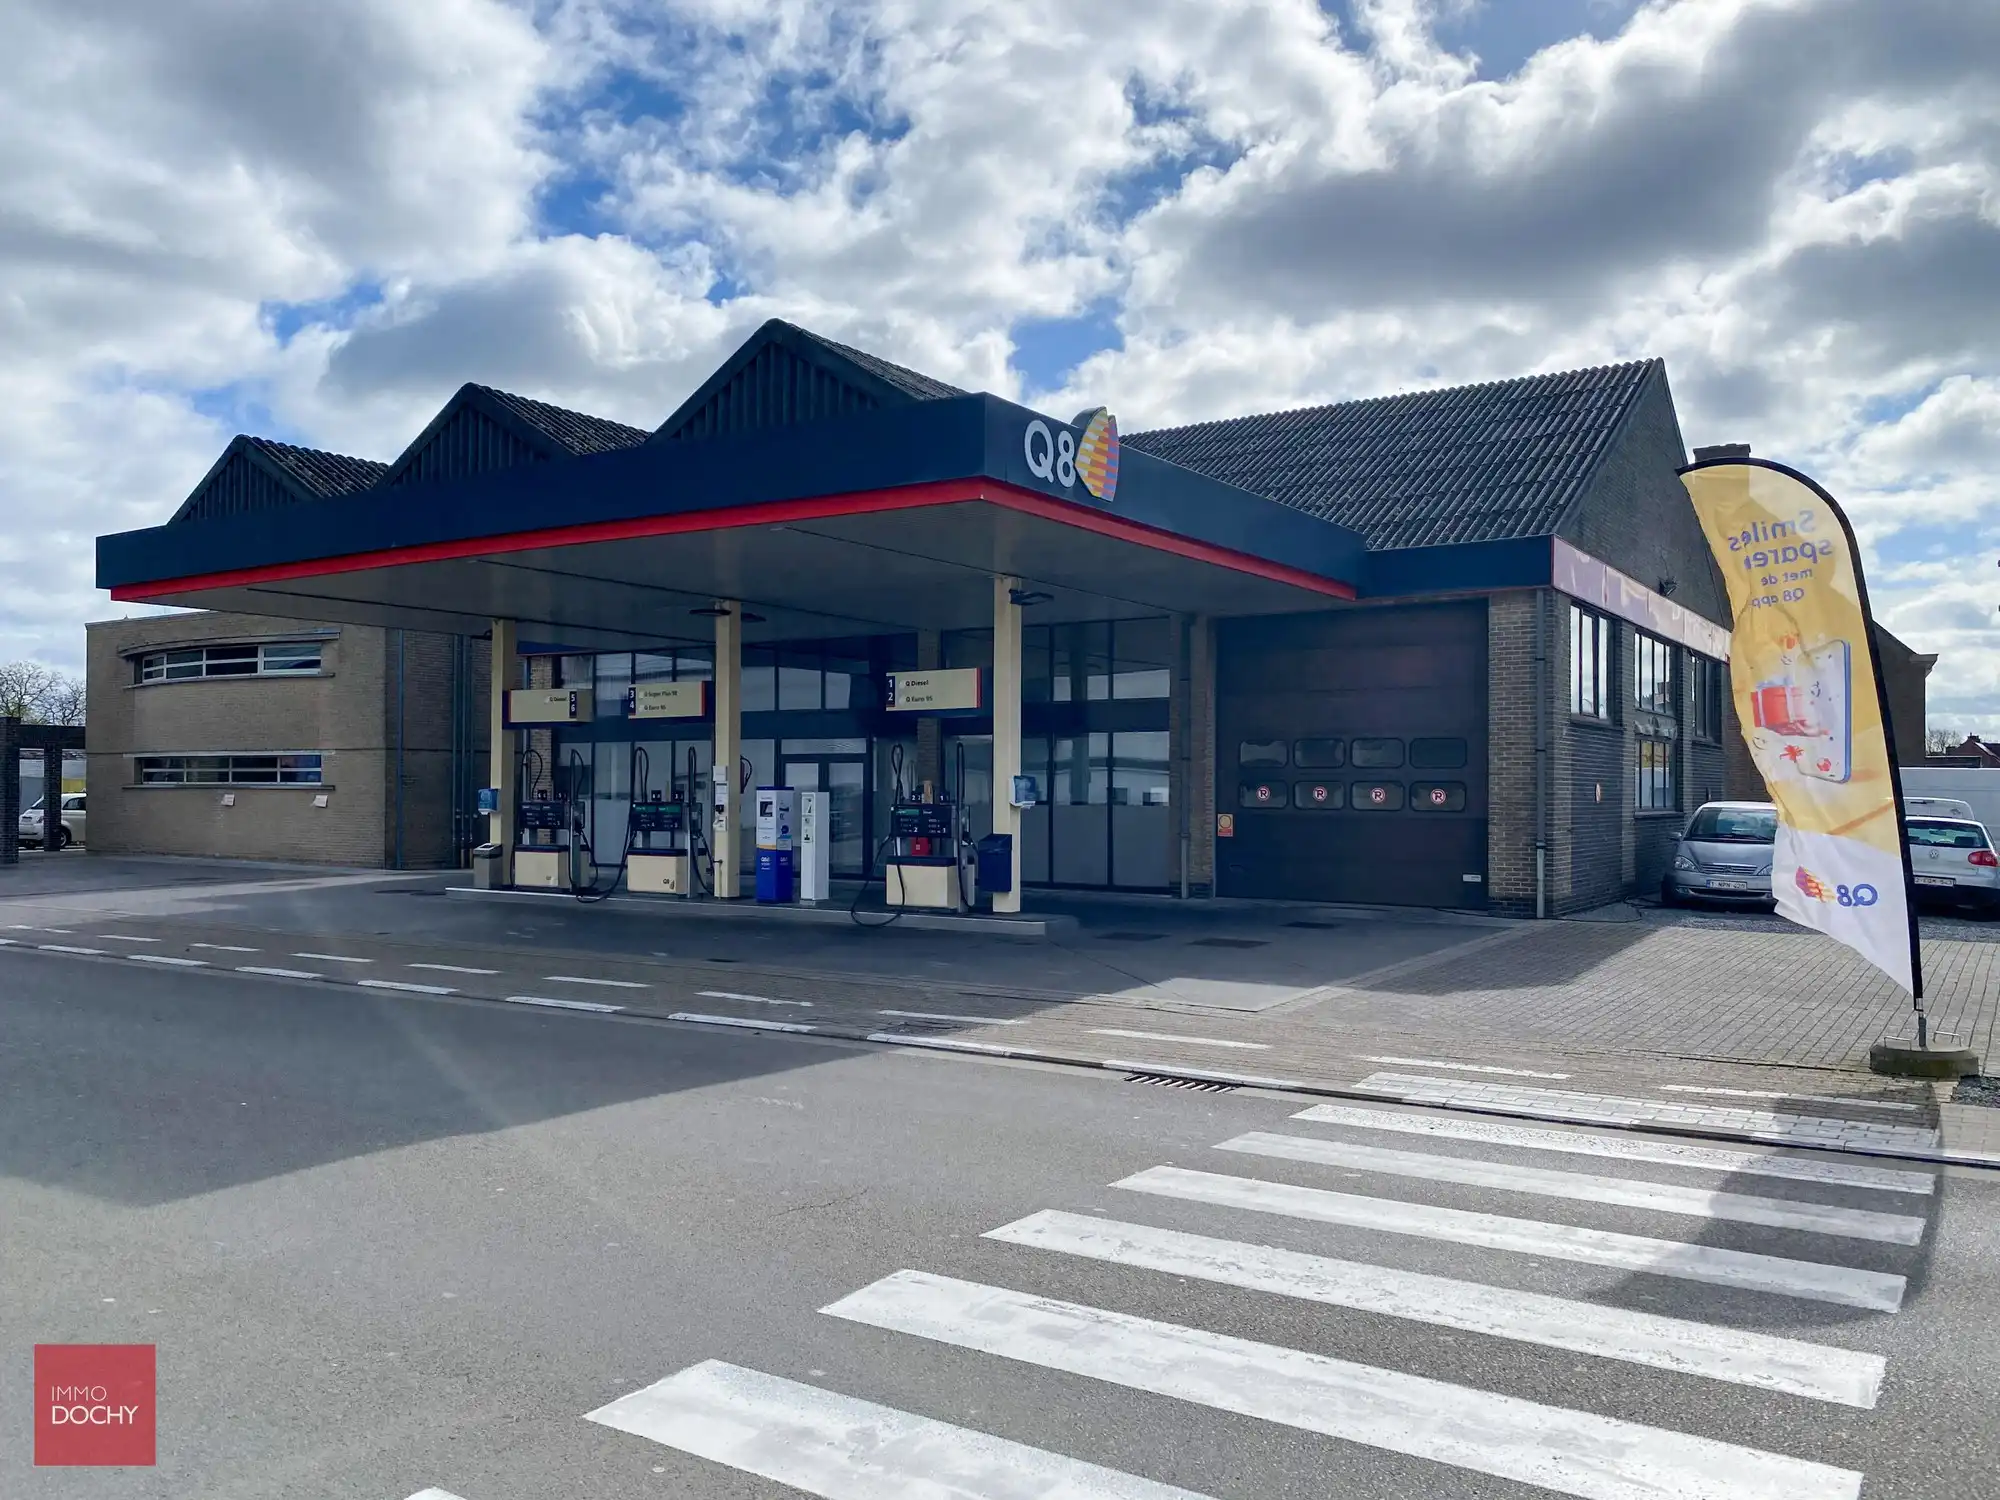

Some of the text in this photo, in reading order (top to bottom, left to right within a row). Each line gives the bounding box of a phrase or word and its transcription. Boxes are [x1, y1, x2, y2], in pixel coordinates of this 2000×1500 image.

[1024, 419, 1077, 488] Q8
[888, 679, 893, 688] 1
[911, 679, 929, 687] Diesel
[570, 693, 576, 702] 5
[629, 690, 635, 699] 3
[888, 692, 893, 701] 2
[570, 704, 576, 712] 6
[629, 700, 635, 709] 4
